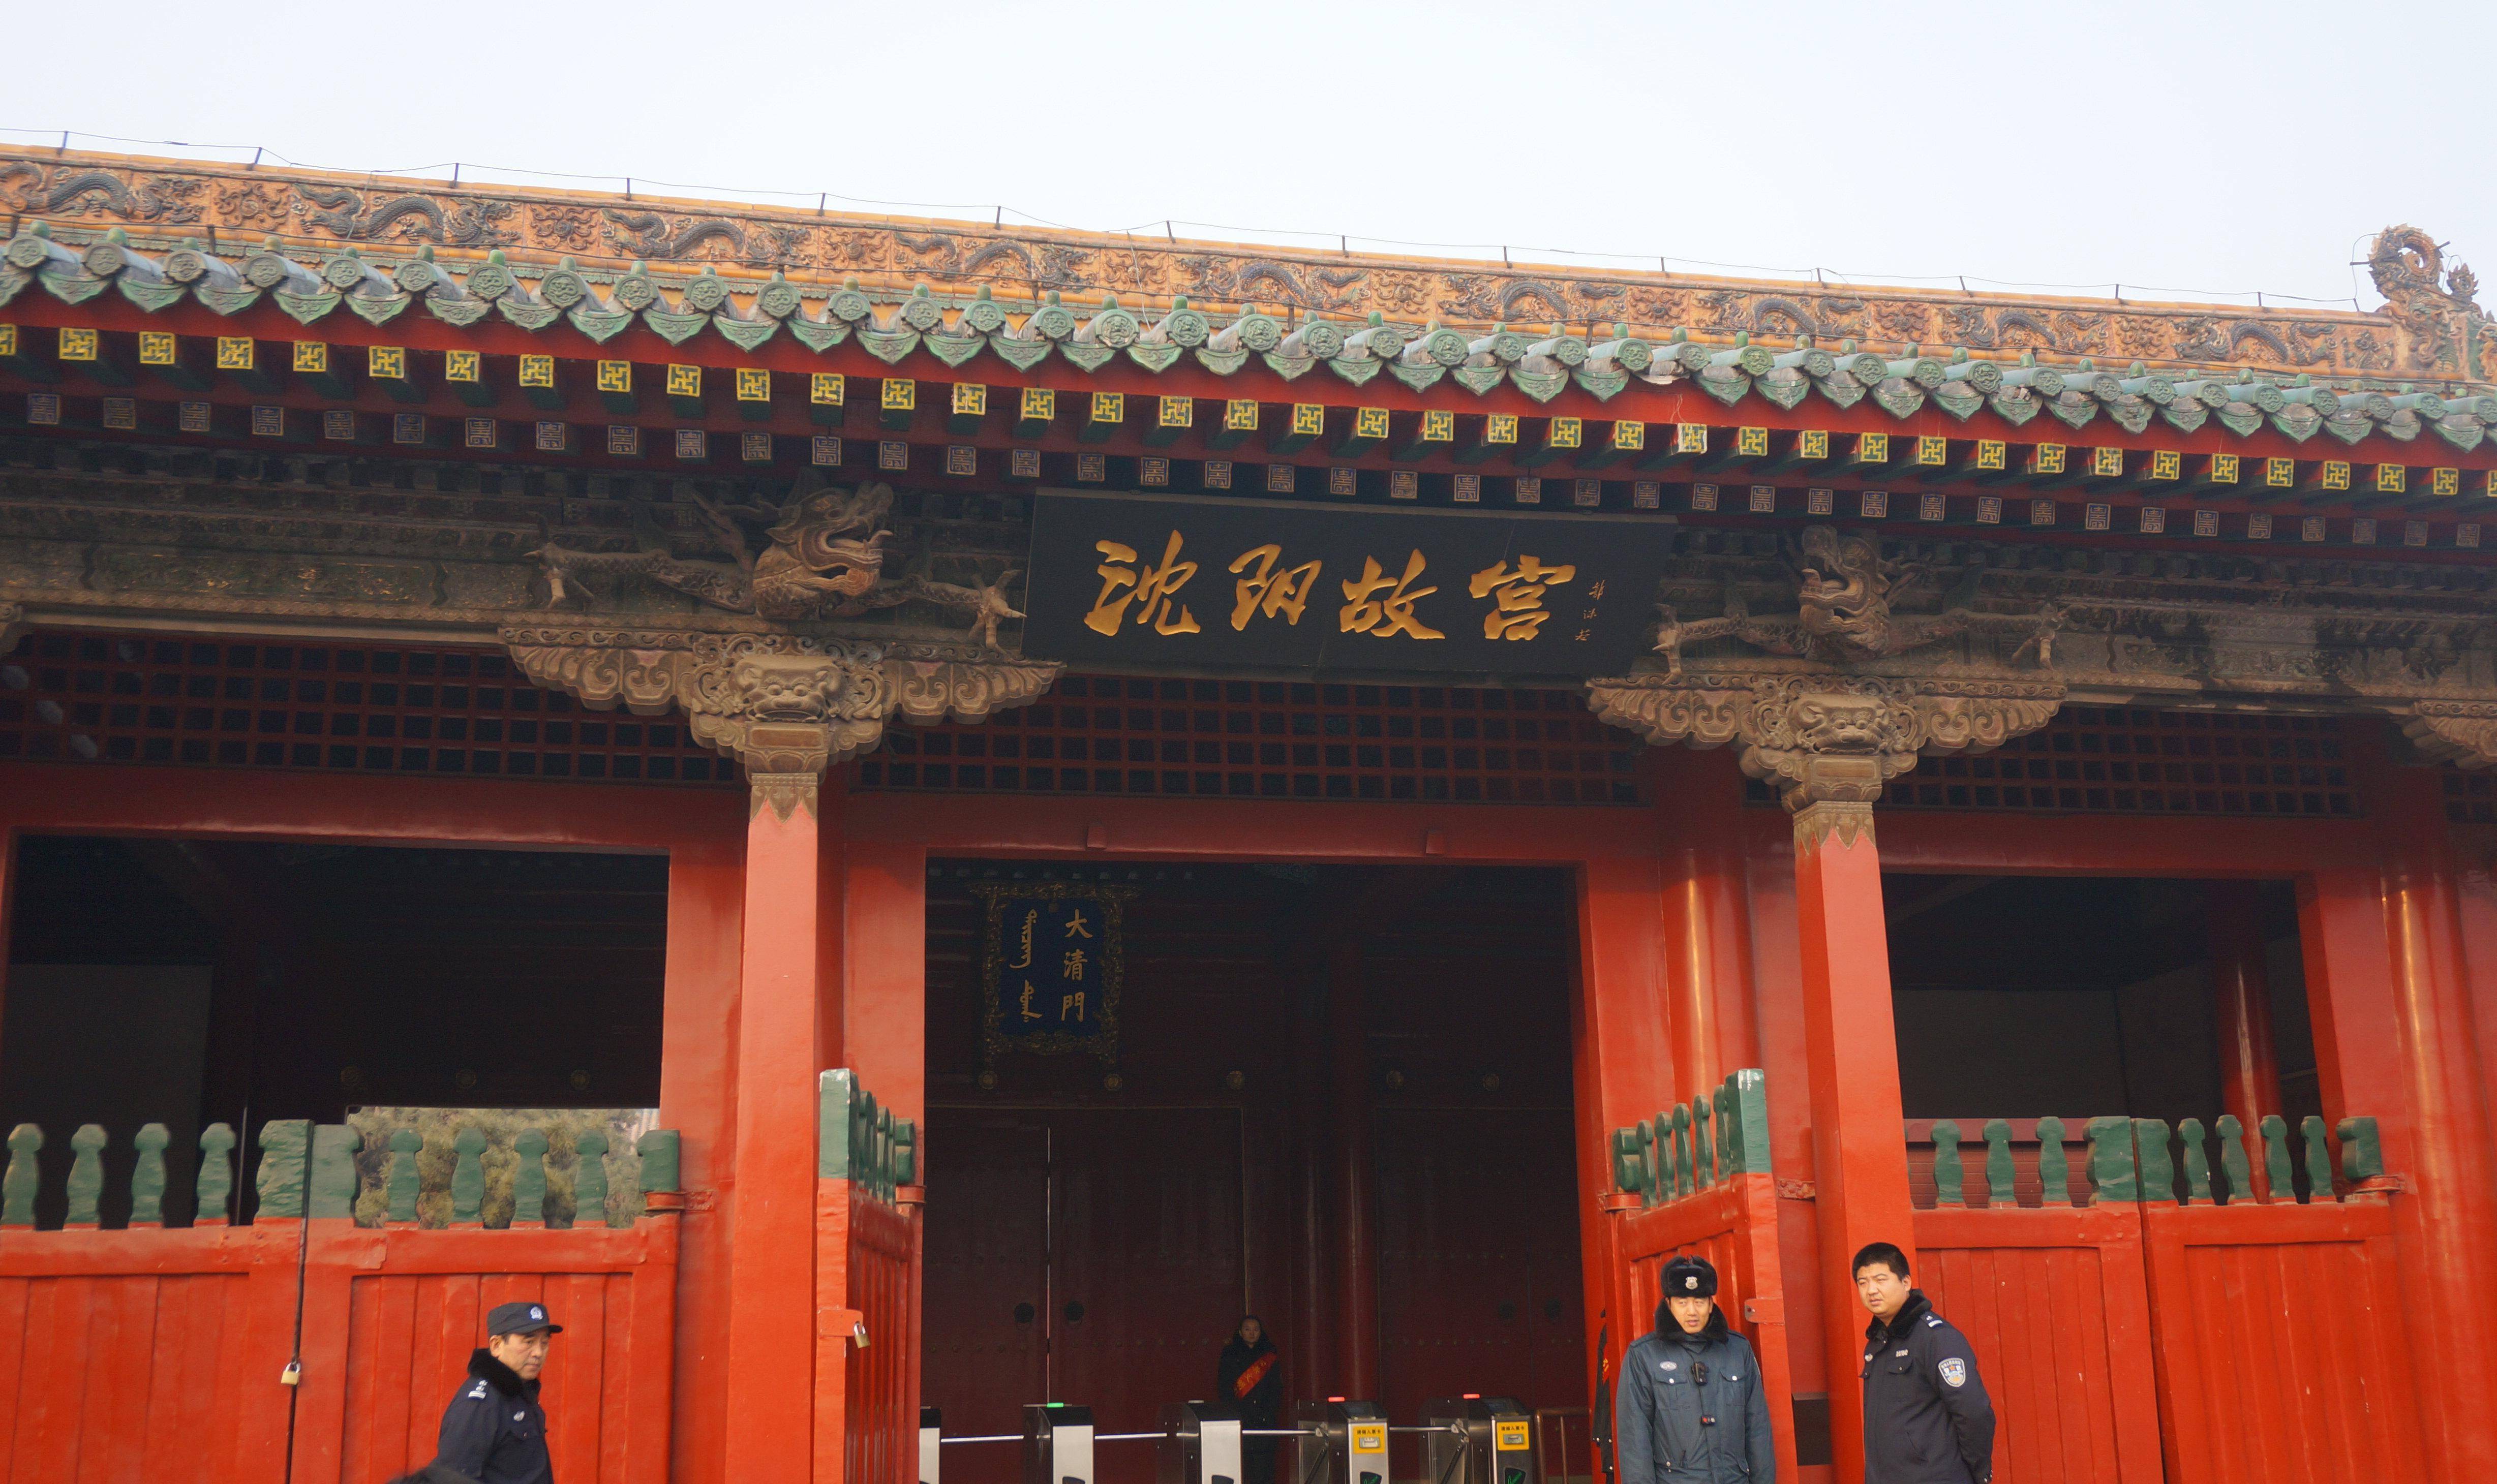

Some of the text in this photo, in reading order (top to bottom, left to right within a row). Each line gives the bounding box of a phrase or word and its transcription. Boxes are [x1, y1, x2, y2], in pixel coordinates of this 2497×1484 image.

[1084, 530, 1576, 641] 沈阳故宫
[1060, 909, 1093, 1022] 大清門
